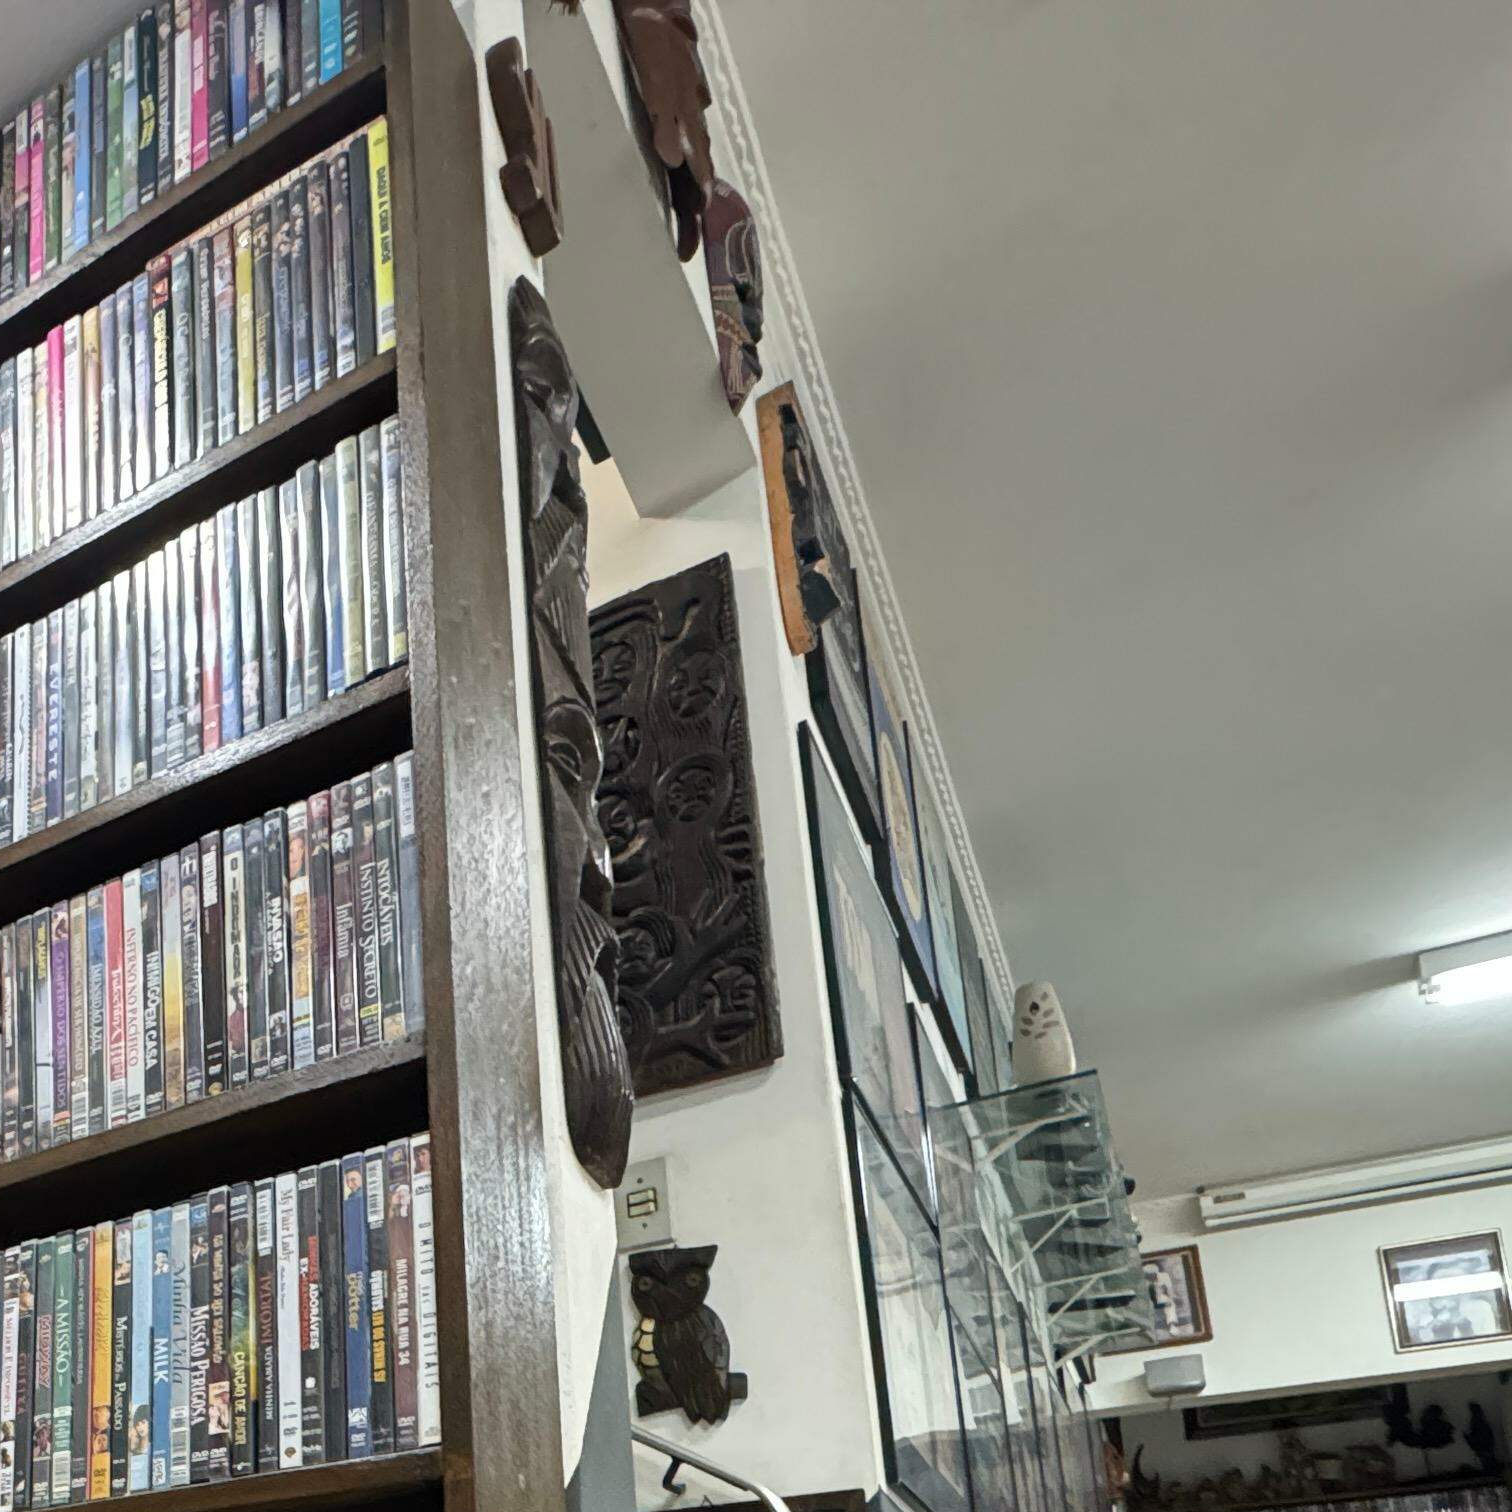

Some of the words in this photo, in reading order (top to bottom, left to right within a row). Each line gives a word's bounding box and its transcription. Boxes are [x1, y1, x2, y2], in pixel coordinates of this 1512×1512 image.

[359, 863, 375, 932] INSTINTO
[335, 903, 353, 958] Infâmia
[146, 951, 160, 1006] INIMIGO
[359, 936, 378, 998] SECRETO
[128, 985, 139, 1005] NO
[145, 1031, 158, 1070] CASA
[281, 1208, 294, 1231] Fair
[279, 1233, 294, 1262] Lady
[419, 1238, 434, 1276] MITO
[171, 1262, 187, 1326] Minha
[396, 1259, 409, 1305] MILAGRE
[55, 1312, 72, 1373] MISSÃO
[190, 1305, 210, 1357] MISSÃO
[308, 1283, 320, 1350] ADORÁVEIS
[397, 1327, 409, 1349] RUA
[115, 1316, 128, 1372] MISTÉRIOS
[153, 1337, 169, 1384] MILK
[172, 1329, 188, 1384] Vida
[421, 1312, 438, 1389] DIGITAIS
[190, 1360, 209, 1425] PERIGOSA
[233, 1351, 247, 1397] CANÇÃO
[114, 1382, 128, 1430] PASSADO
